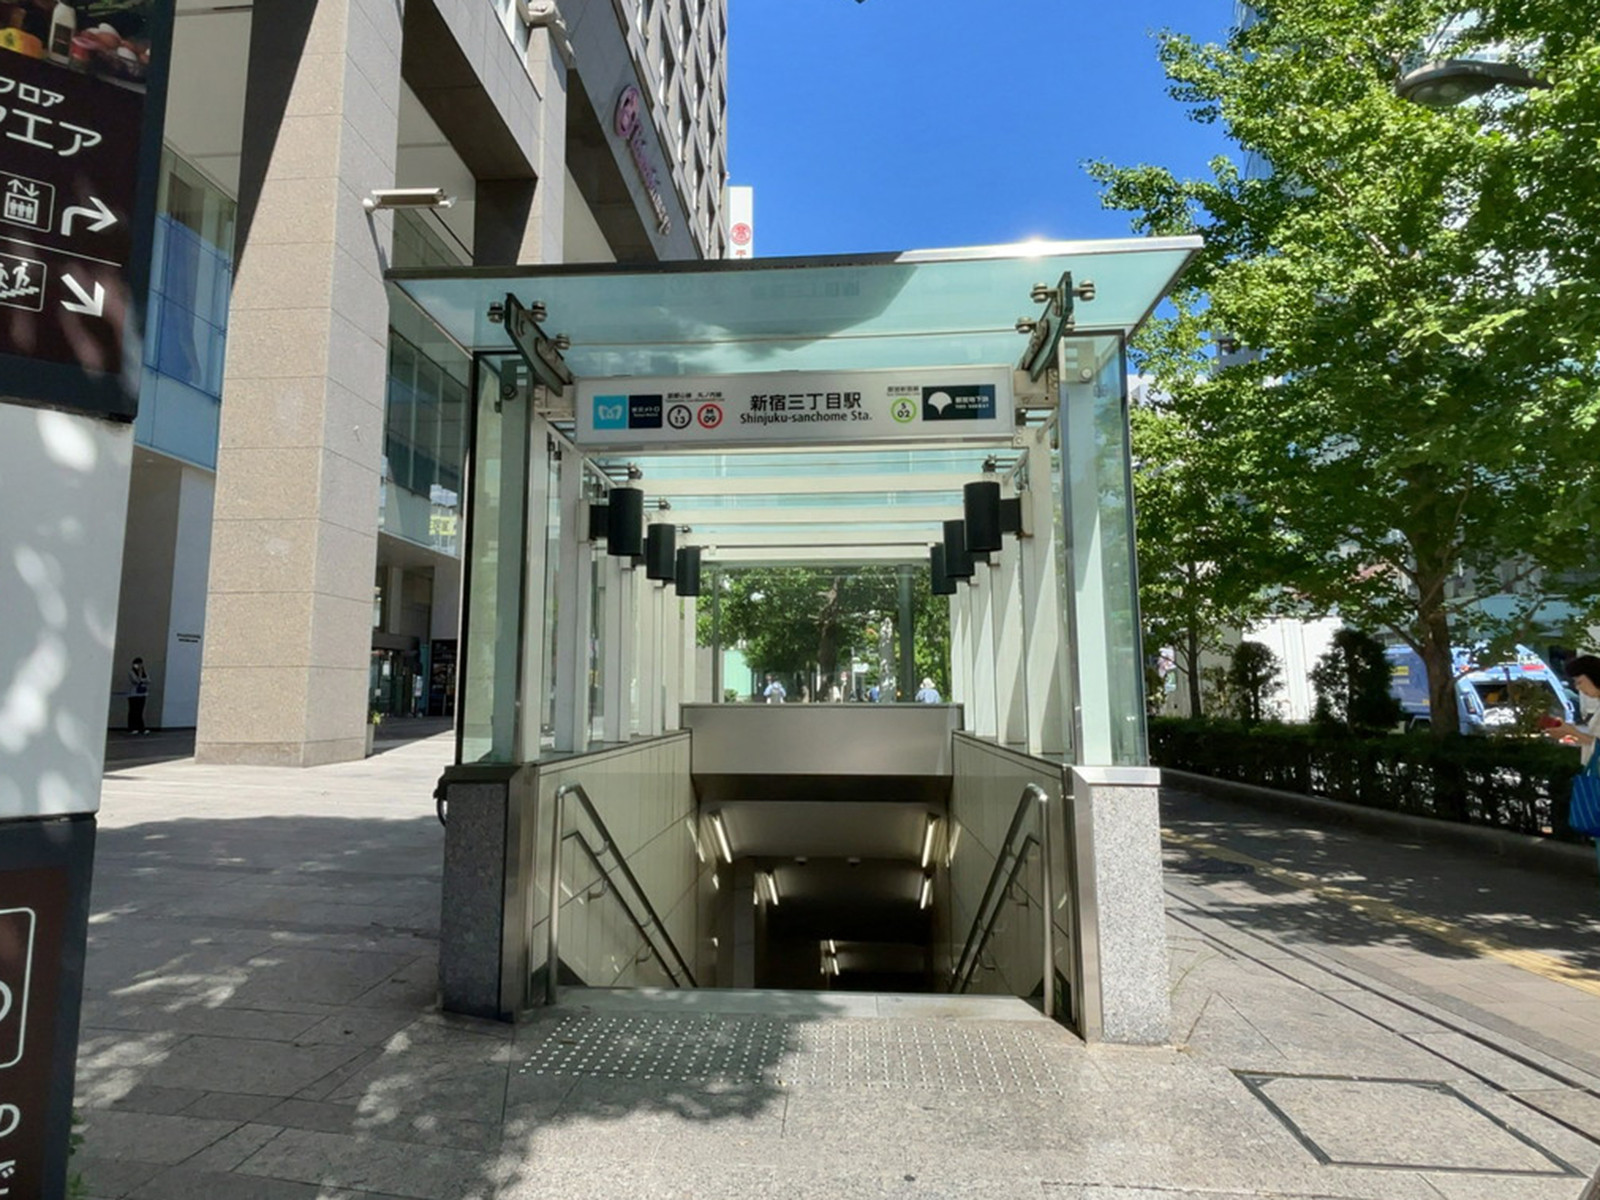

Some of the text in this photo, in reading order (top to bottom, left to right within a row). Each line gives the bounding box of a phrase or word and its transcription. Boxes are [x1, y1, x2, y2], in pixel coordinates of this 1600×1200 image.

[0, 105, 102, 157] エア
[750, 392, 862, 412] 新宿三丁目駅
[674, 416, 686, 424] 13
[703, 415, 717, 424] 09
[740, 410, 873, 425] Shinjuku-sanchome Sta.
[897, 410, 911, 418] 02
